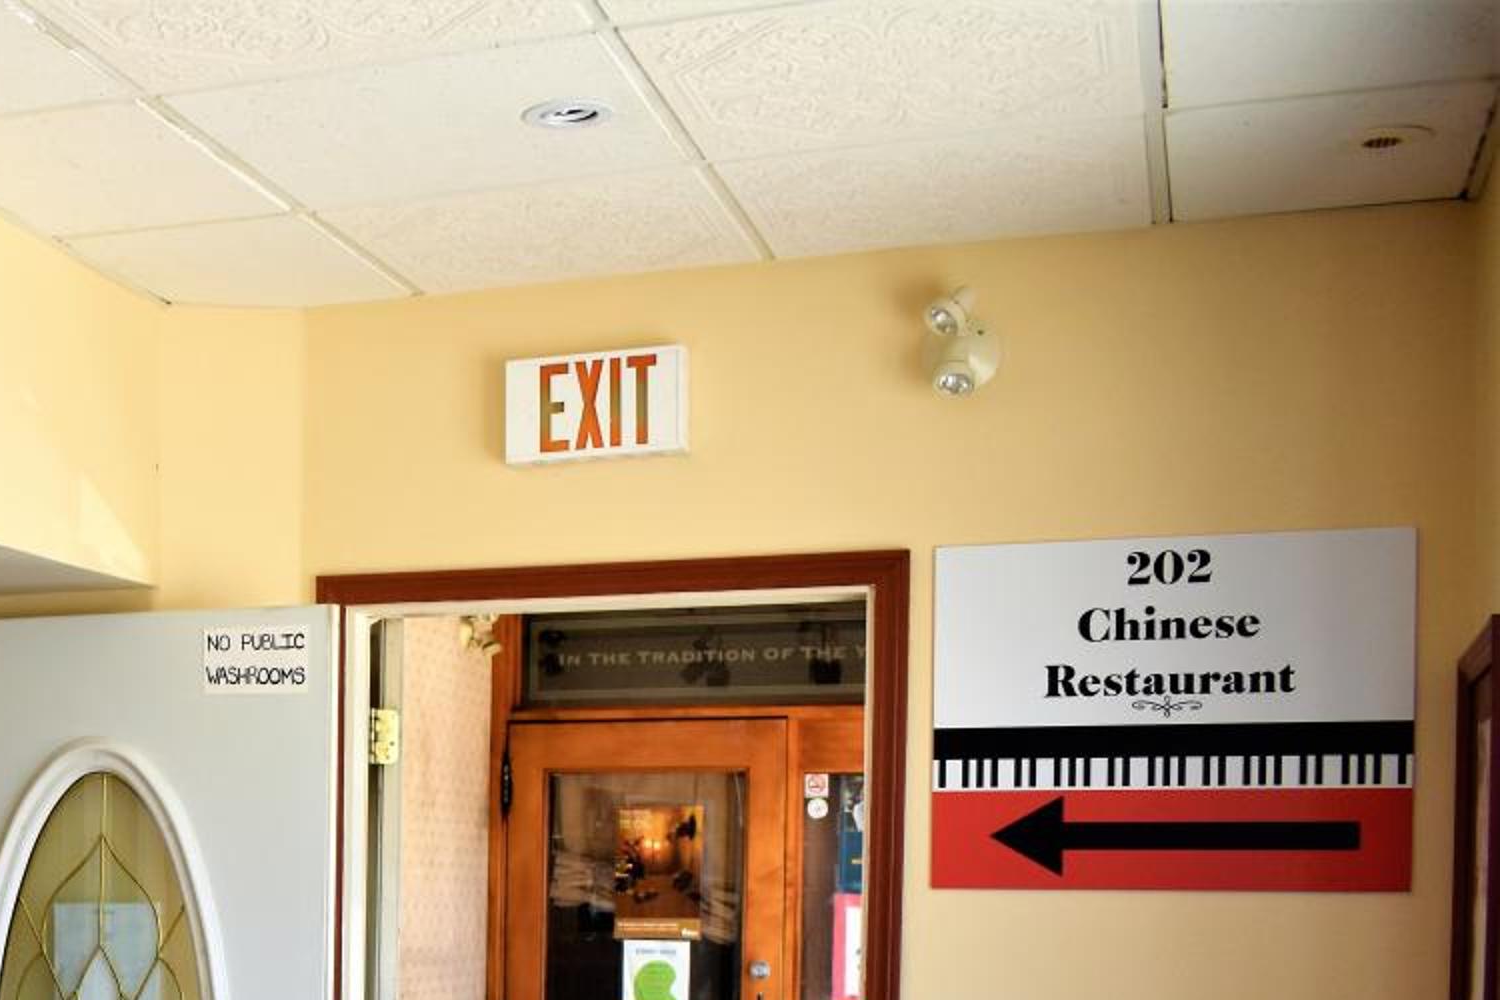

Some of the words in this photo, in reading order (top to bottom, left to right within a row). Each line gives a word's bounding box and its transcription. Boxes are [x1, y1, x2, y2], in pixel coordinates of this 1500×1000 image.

[540, 354, 657, 452] EXIT
[1127, 549, 1213, 585] 202
[1078, 605, 1260, 643] Chinese
[207, 634, 231, 651] NO
[241, 633, 305, 650] PUBLIC
[559, 653, 581, 667] IN
[589, 652, 631, 666] THE
[639, 649, 755, 665] TRADITION
[763, 648, 794, 661] OF
[800, 646, 846, 660] THE
[206, 666, 305, 685] WASHROOMS
[1045, 664, 1296, 697] Restaurant
